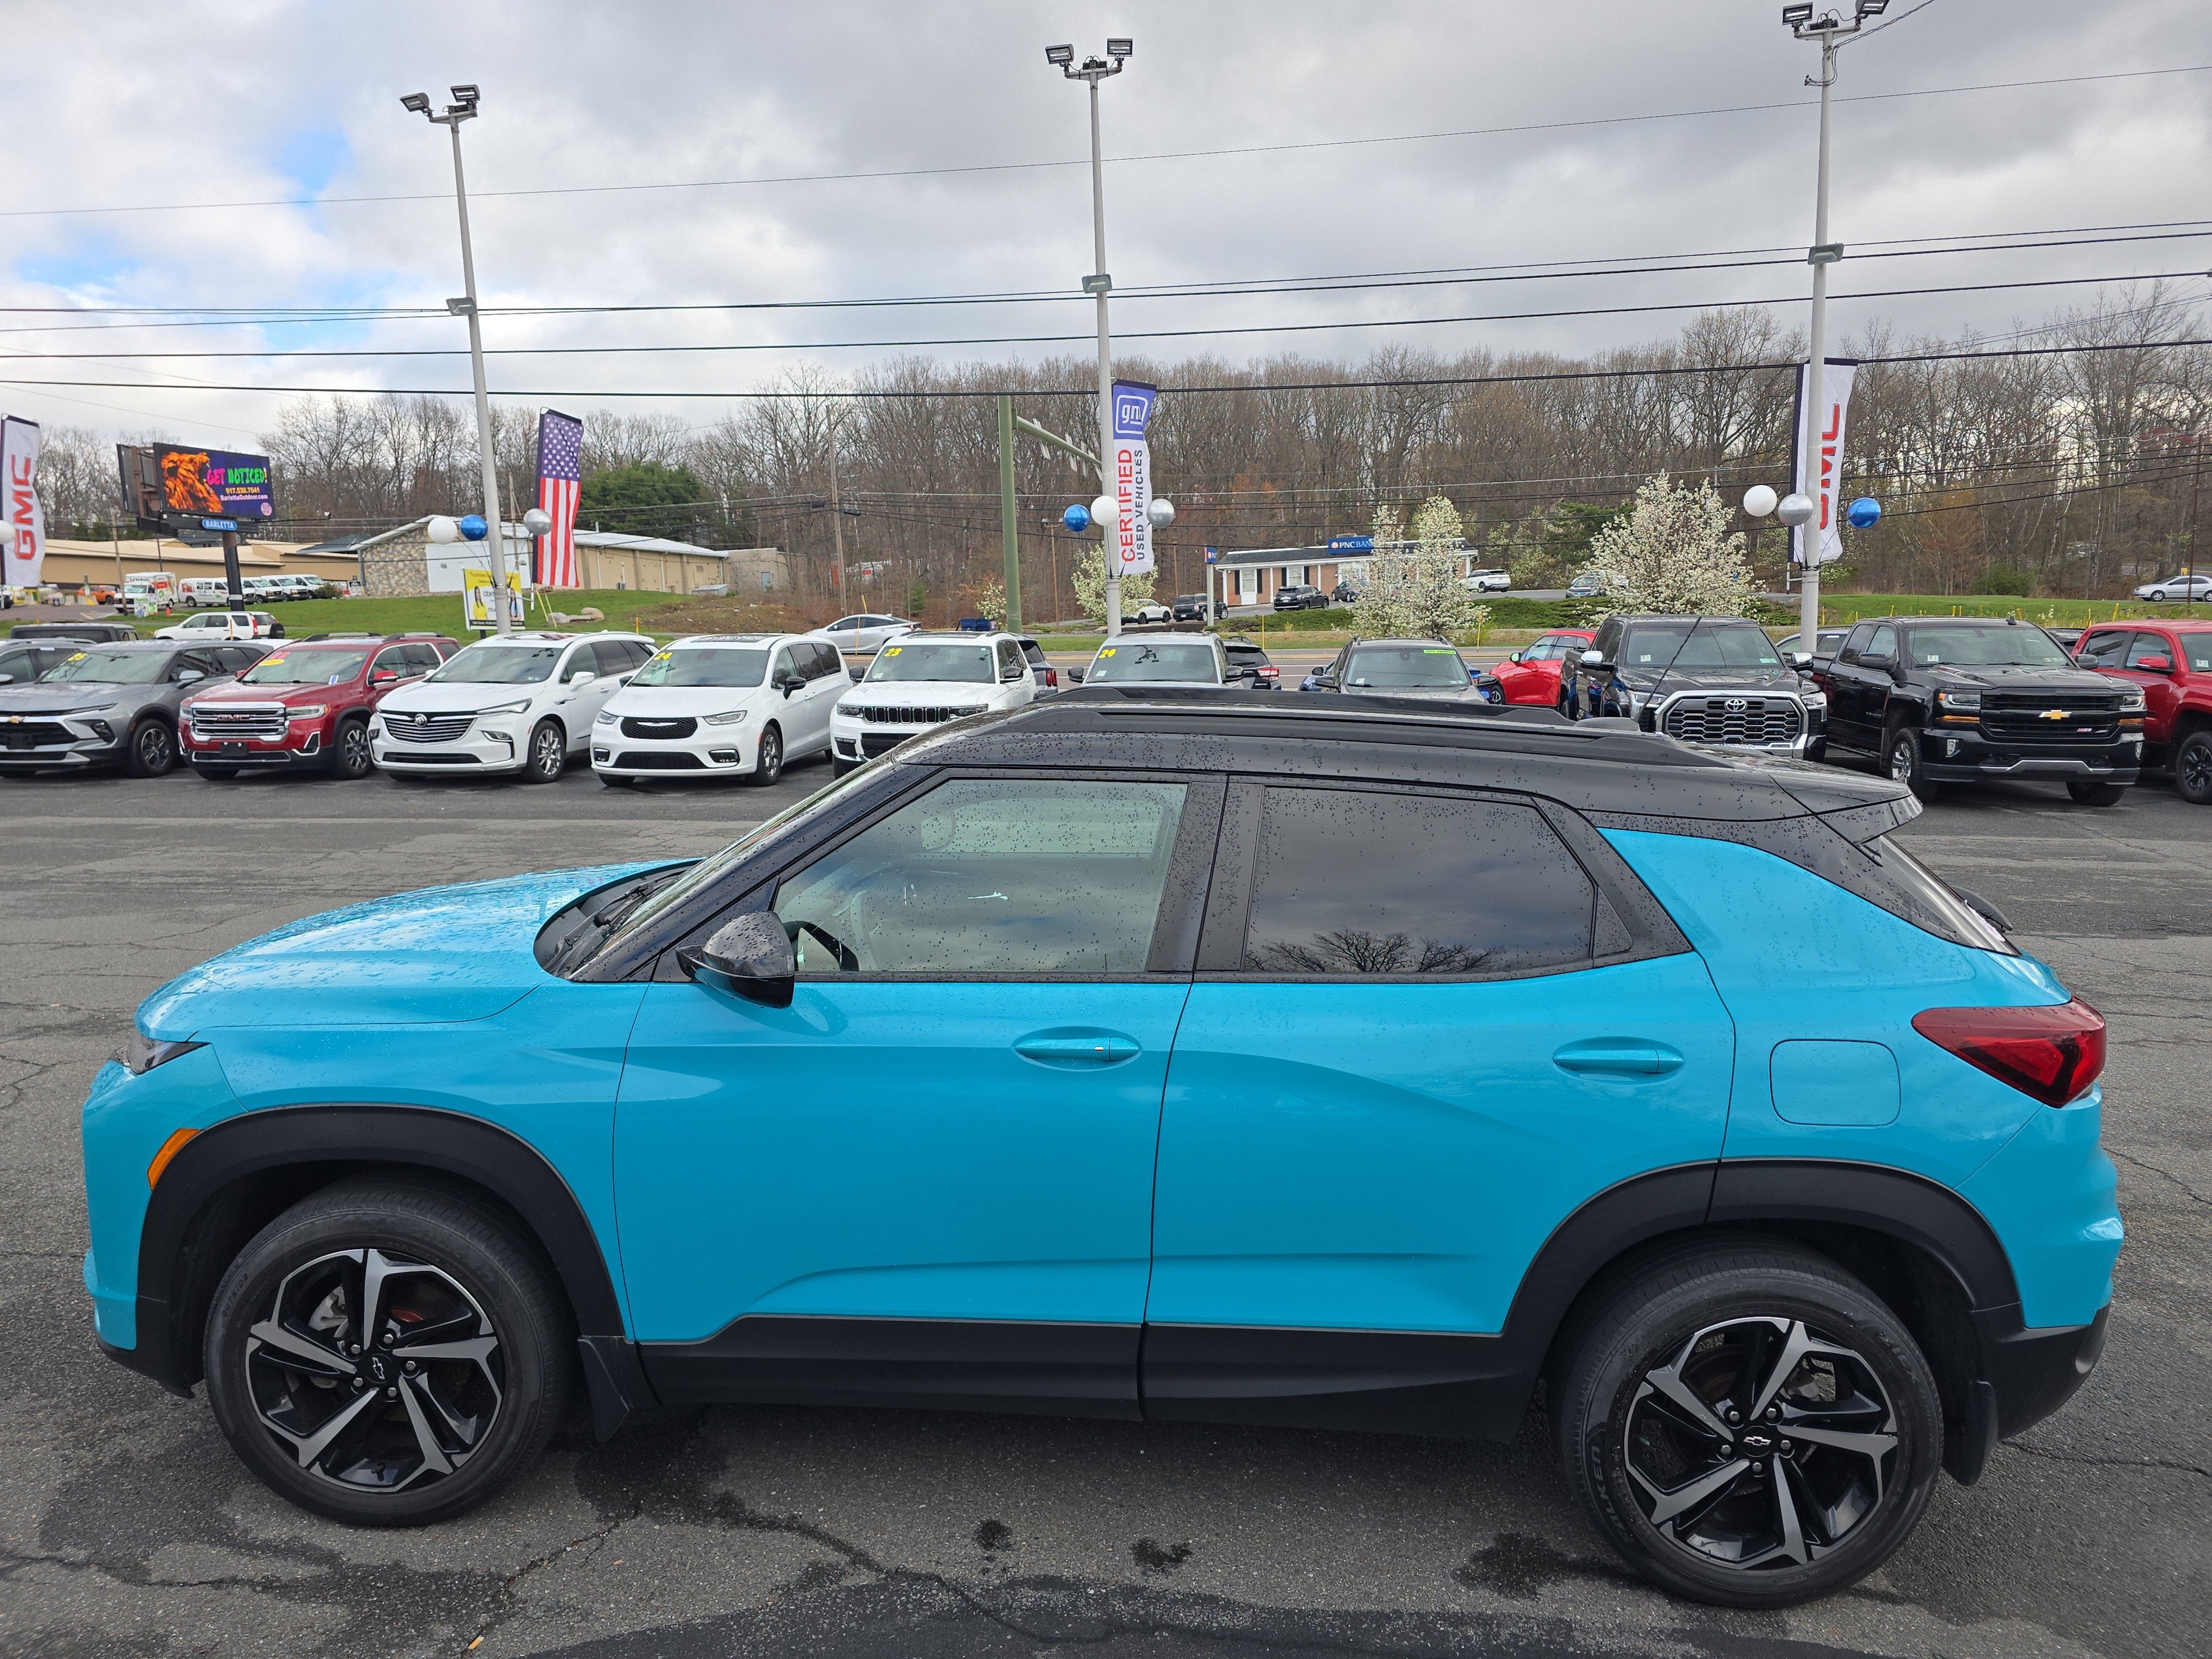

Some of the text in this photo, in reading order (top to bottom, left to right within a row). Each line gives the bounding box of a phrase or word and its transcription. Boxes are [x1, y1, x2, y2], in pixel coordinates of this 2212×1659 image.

[1122, 404, 1141, 425] gm
[207, 467, 268, 485] GET NOTICED!
[11, 454, 37, 561] GMC
[1117, 448, 1136, 562] CERTIFIED
[1134, 449, 1146, 560] USED VEHICLES
[205, 518, 234, 529] BARLETTA
[653, 652, 673, 660] 24
[884, 648, 903, 657] 23
